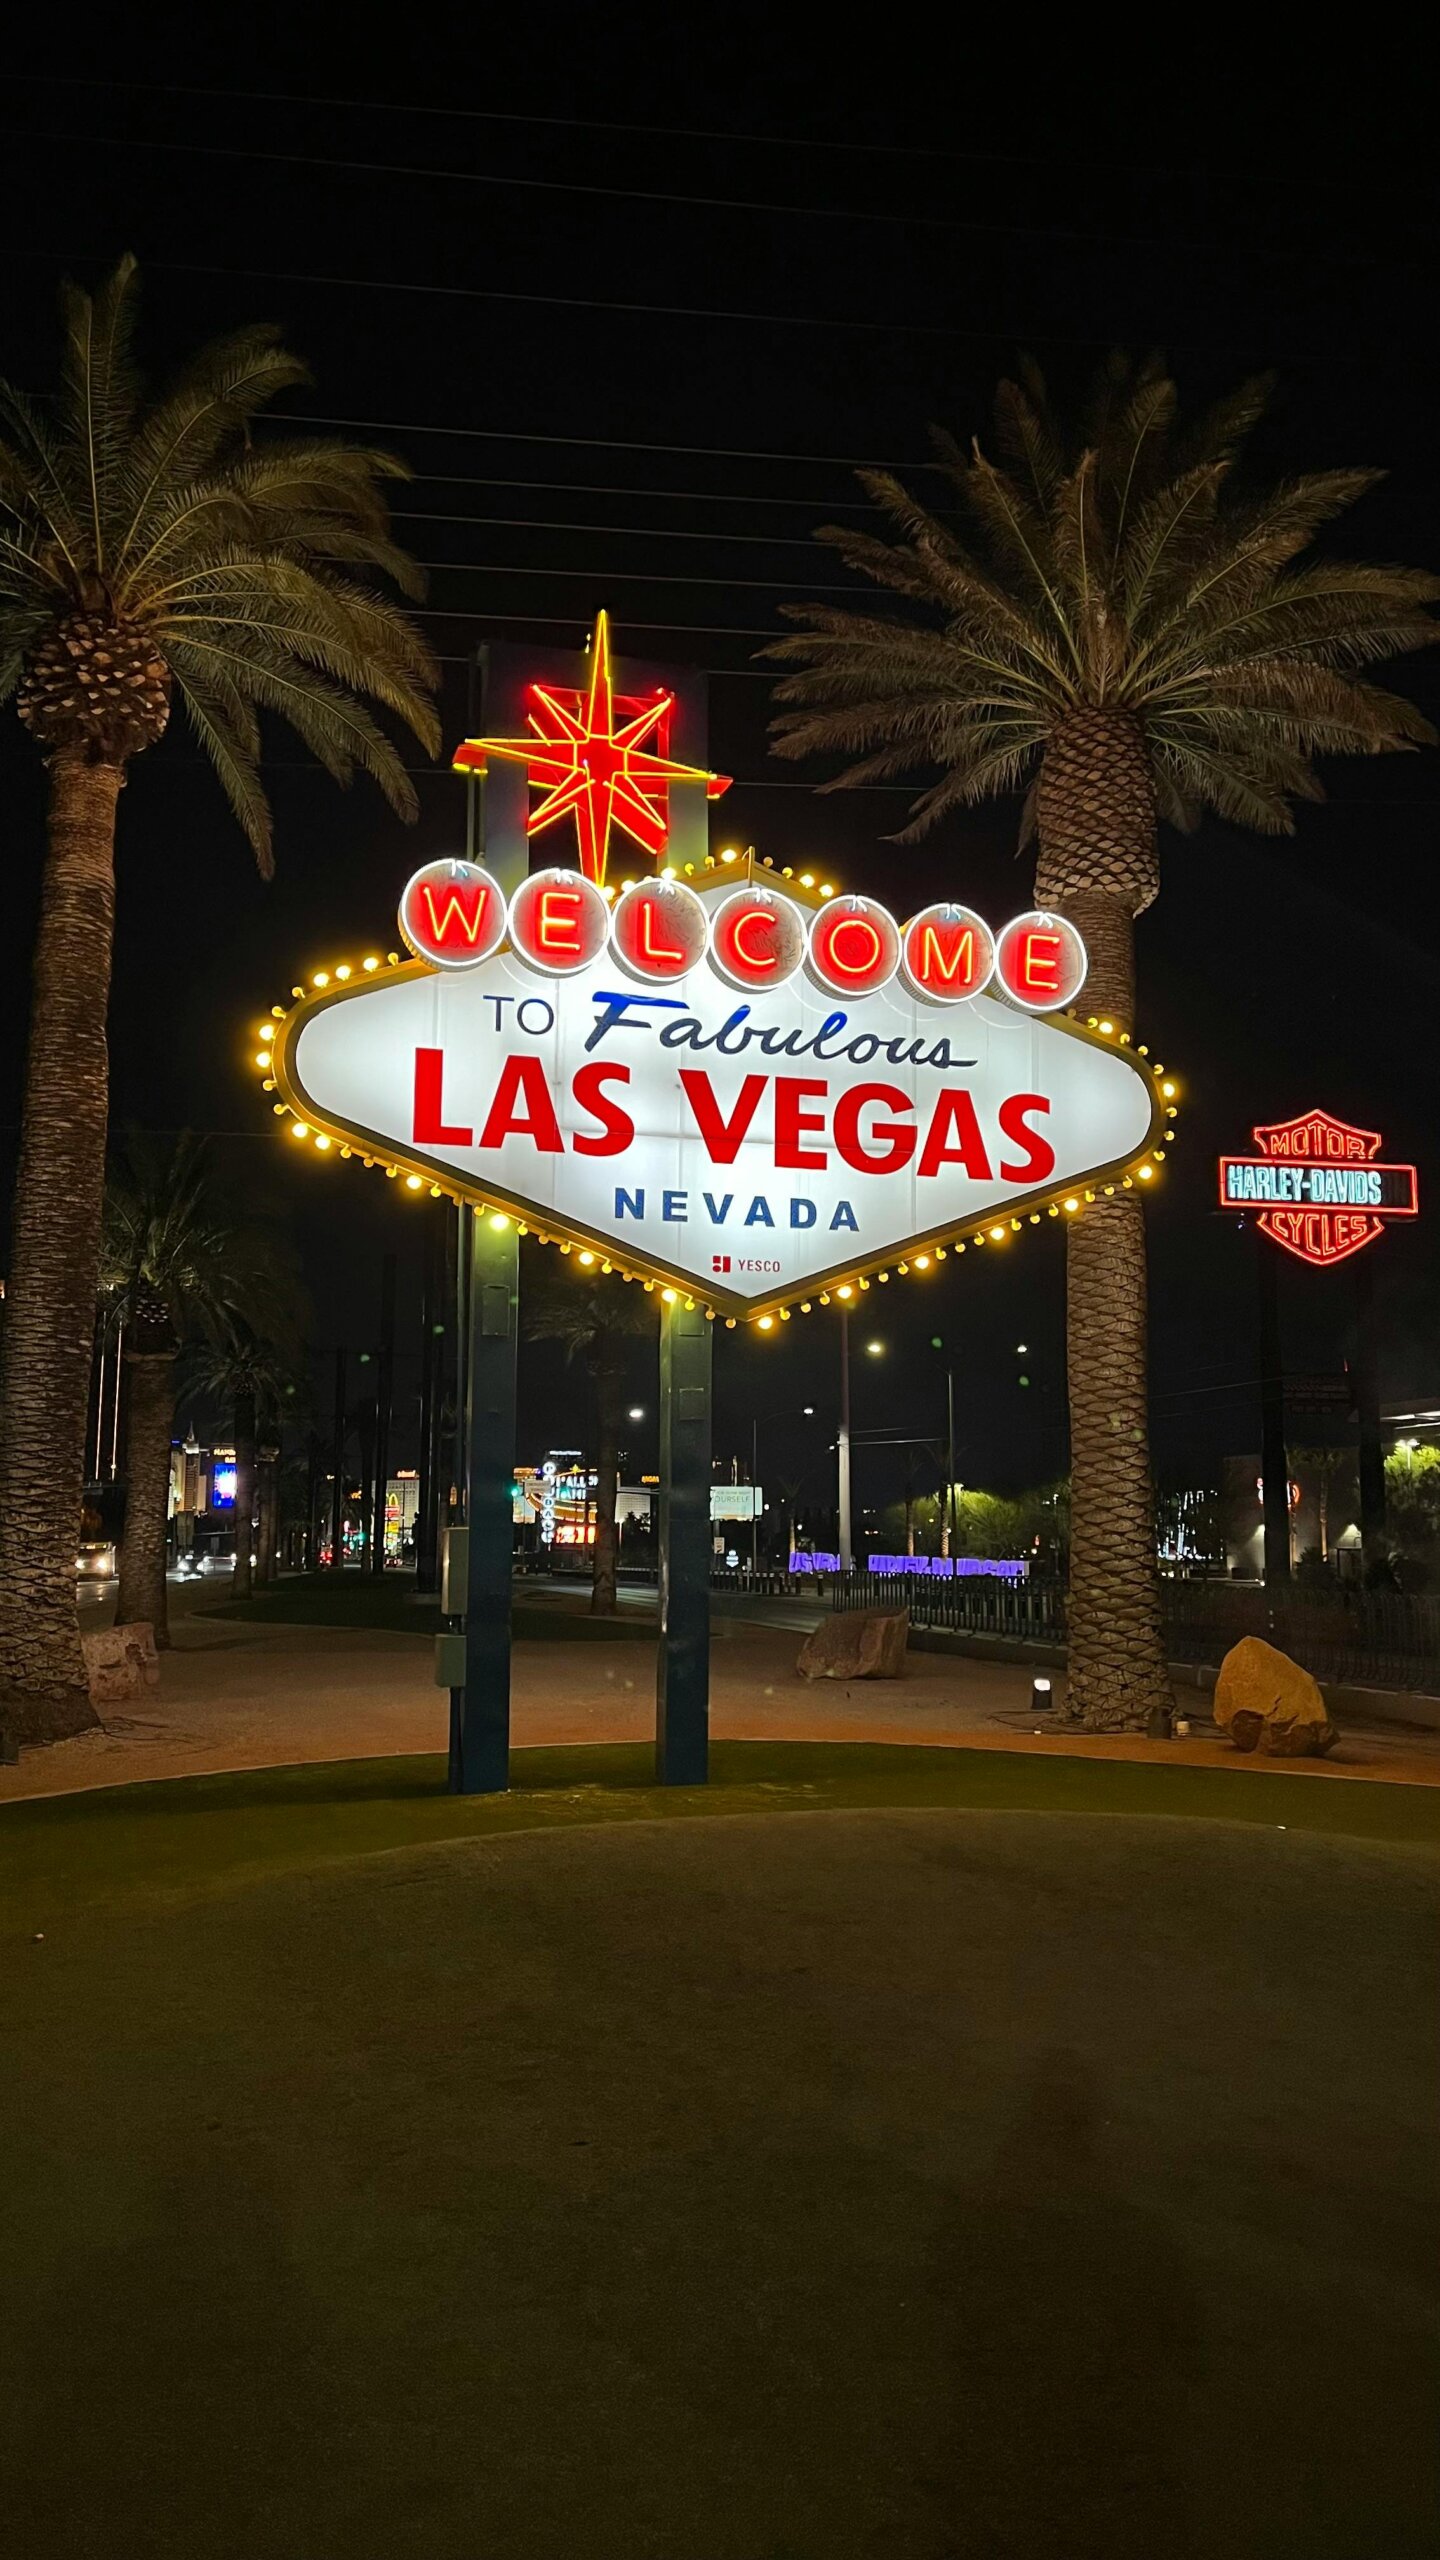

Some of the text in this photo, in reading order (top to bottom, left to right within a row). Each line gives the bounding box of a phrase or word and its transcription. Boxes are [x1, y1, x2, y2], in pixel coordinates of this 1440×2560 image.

[420, 882, 1064, 992] WELCOME
[482, 990, 979, 1069] TO Fabulous
[412, 1046, 1056, 1184] LAS VEGAS
[1270, 1118, 1367, 1159] MOTOR
[613, 1186, 861, 1233] NEVADA
[1271, 1211, 1368, 1257] CYCLES
[737, 1258, 782, 1274] YESCO
